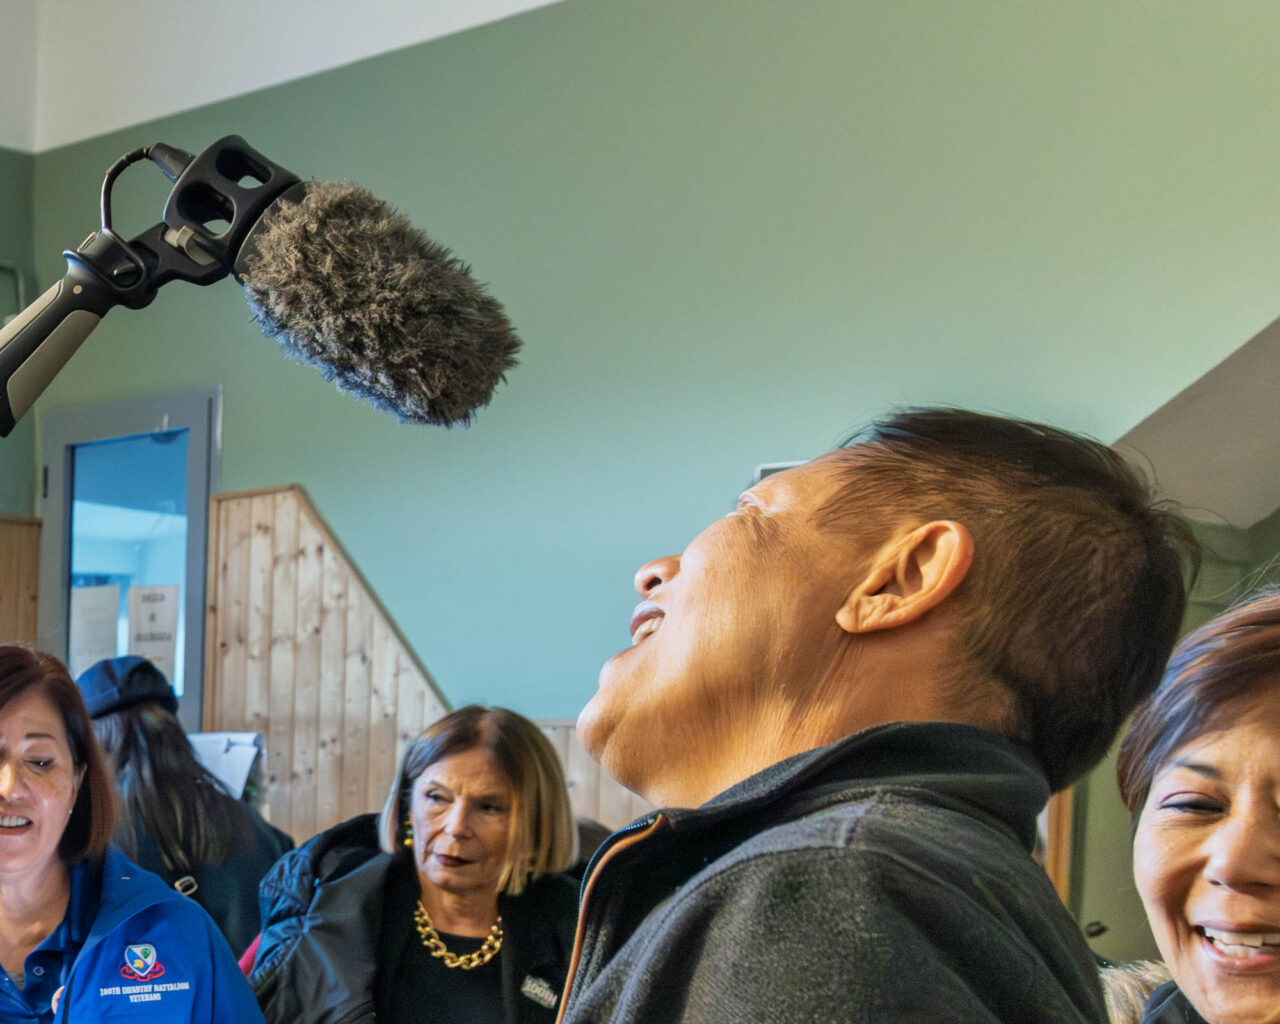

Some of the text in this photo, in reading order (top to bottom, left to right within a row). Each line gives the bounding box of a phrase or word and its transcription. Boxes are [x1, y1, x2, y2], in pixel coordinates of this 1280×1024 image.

[122, 984, 153, 995] INFANTRY
[154, 982, 190, 992] BATTALION
[129, 993, 162, 1003] VETERANS
